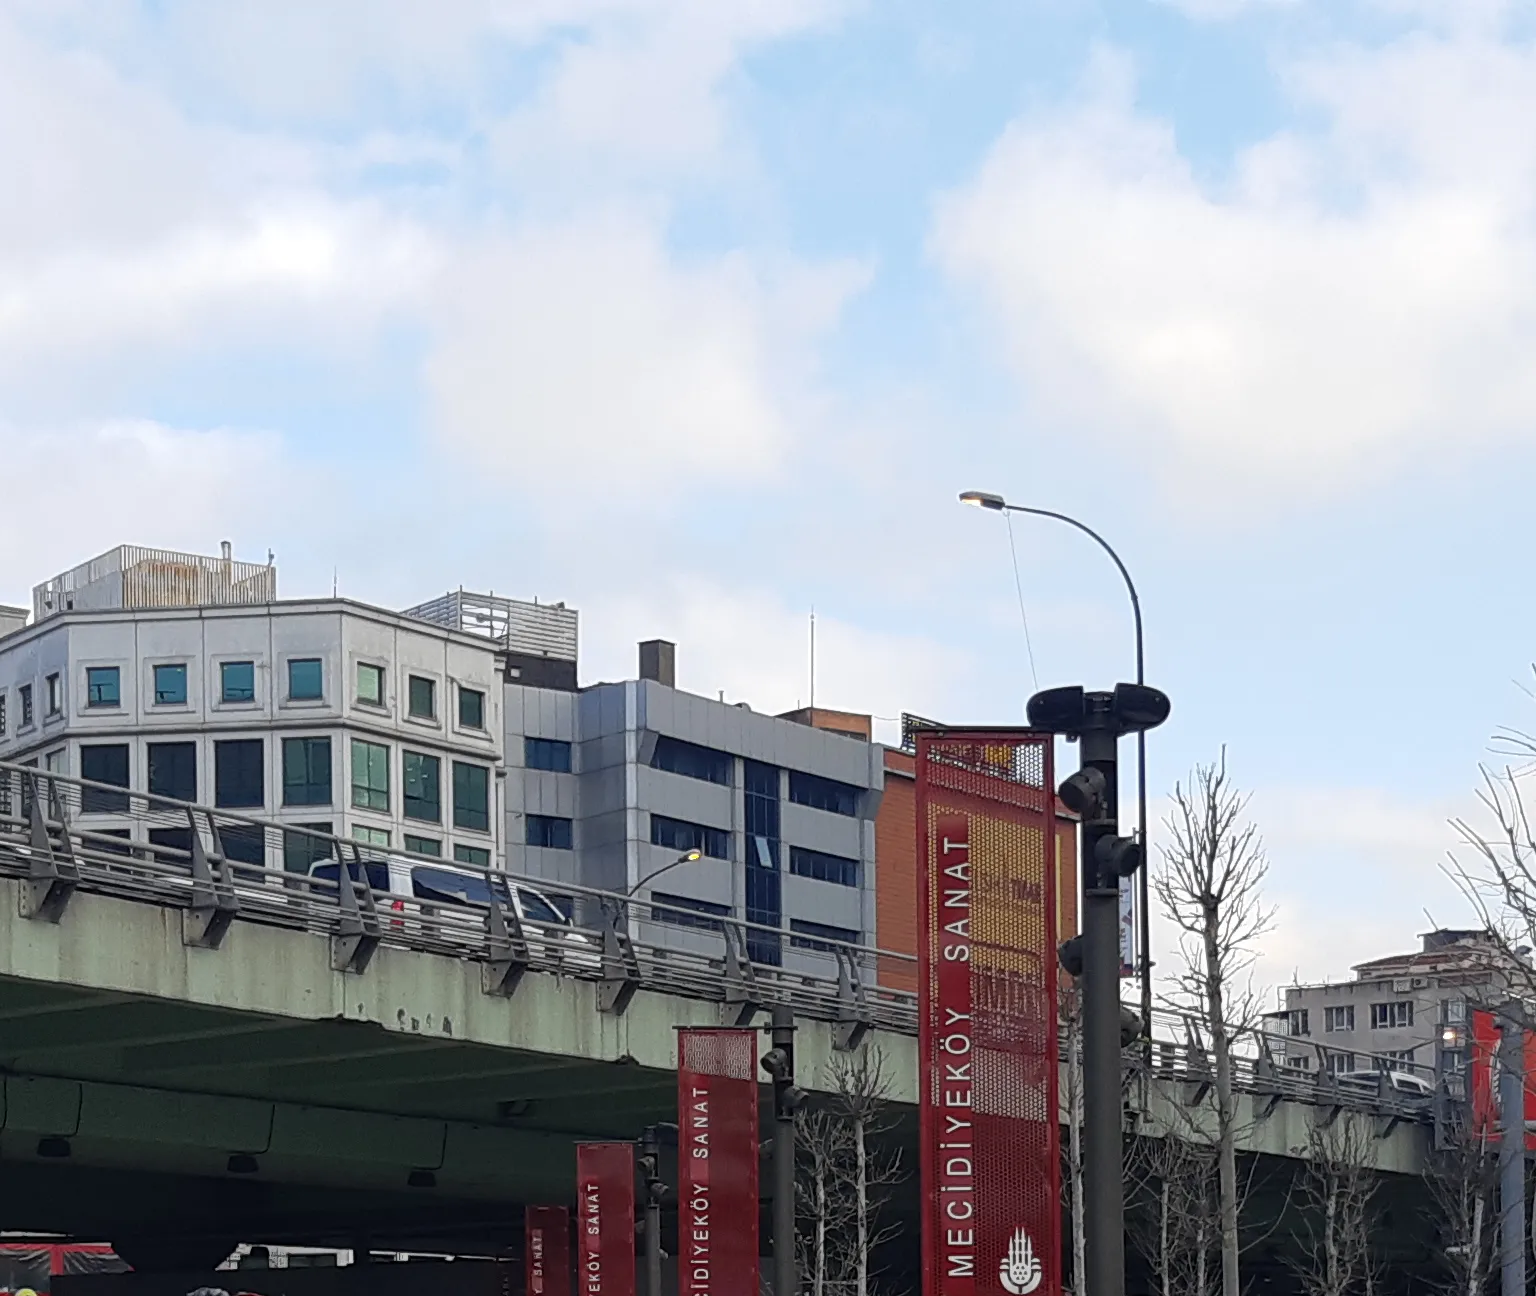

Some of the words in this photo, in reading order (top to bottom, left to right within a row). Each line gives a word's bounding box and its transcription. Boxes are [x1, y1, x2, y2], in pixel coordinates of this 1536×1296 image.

[943, 836, 973, 963] SANAT
[692, 1087, 709, 1159] SANAT
[939, 1007, 975, 1279] MECİDİYEKÖY
[587, 1183, 600, 1235] SANAT
[532, 1236, 543, 1276] SANAT
